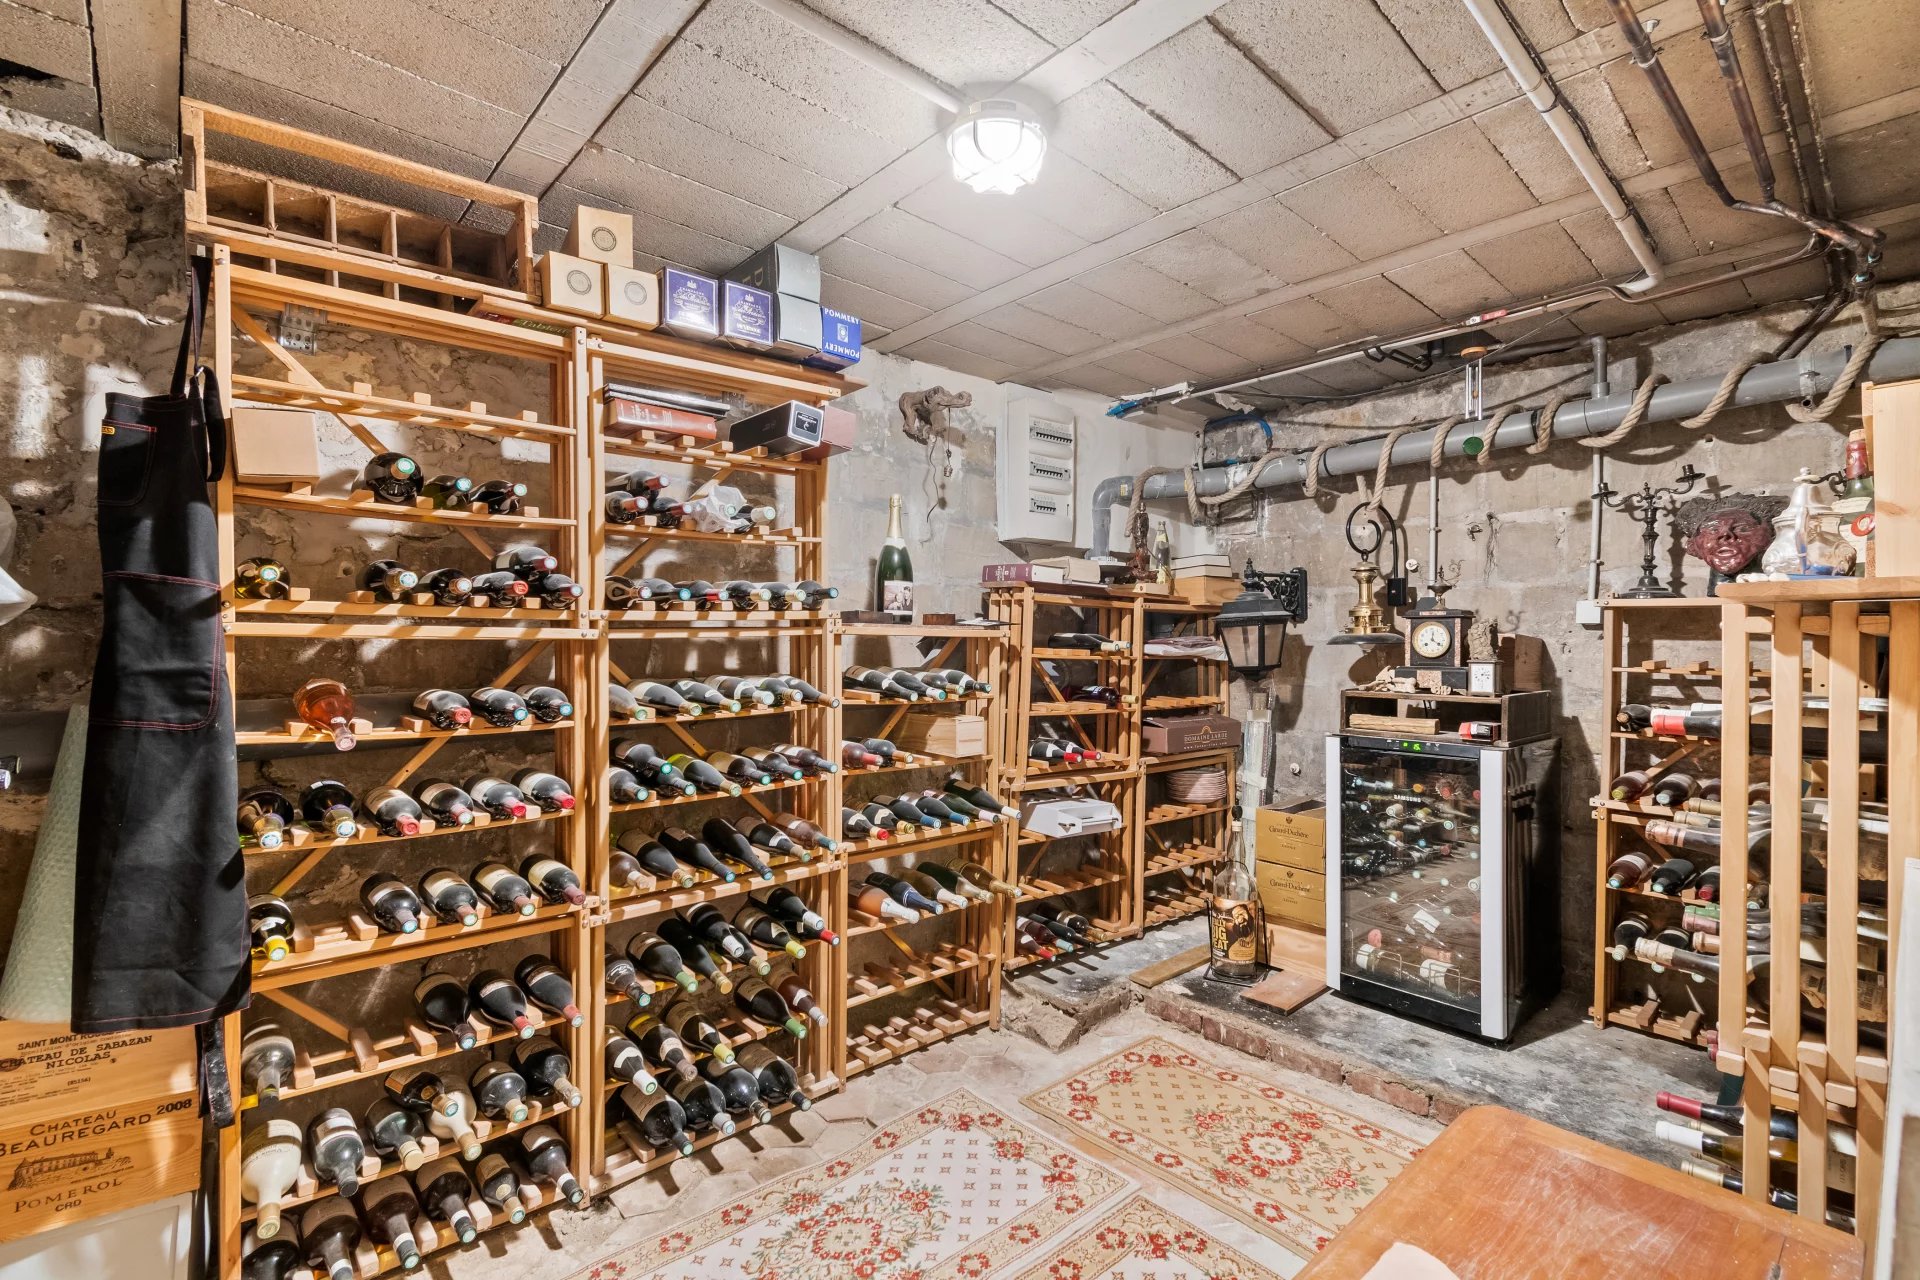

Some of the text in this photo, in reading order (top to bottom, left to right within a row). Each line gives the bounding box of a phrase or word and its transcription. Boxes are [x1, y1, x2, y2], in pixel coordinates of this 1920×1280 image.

[824, 308, 859, 325] POMMERY
[824, 341, 860, 359] POMMERY
[1393, 794, 1422, 803] SAMSUNG
[17, 1039, 48, 1050] SAINT
[49, 1034, 78, 1045] MONT
[70, 1047, 87, 1056] DE
[96, 1035, 152, 1051] SABAZAN
[45, 1051, 111, 1070] NICOLAS
[0, 1099, 192, 1157] BEAUREGARD 2008
[30, 1110, 116, 1136] CHATEAU
[14, 1178, 122, 1213] POMEROL
[55, 1199, 82, 1212] CRD
